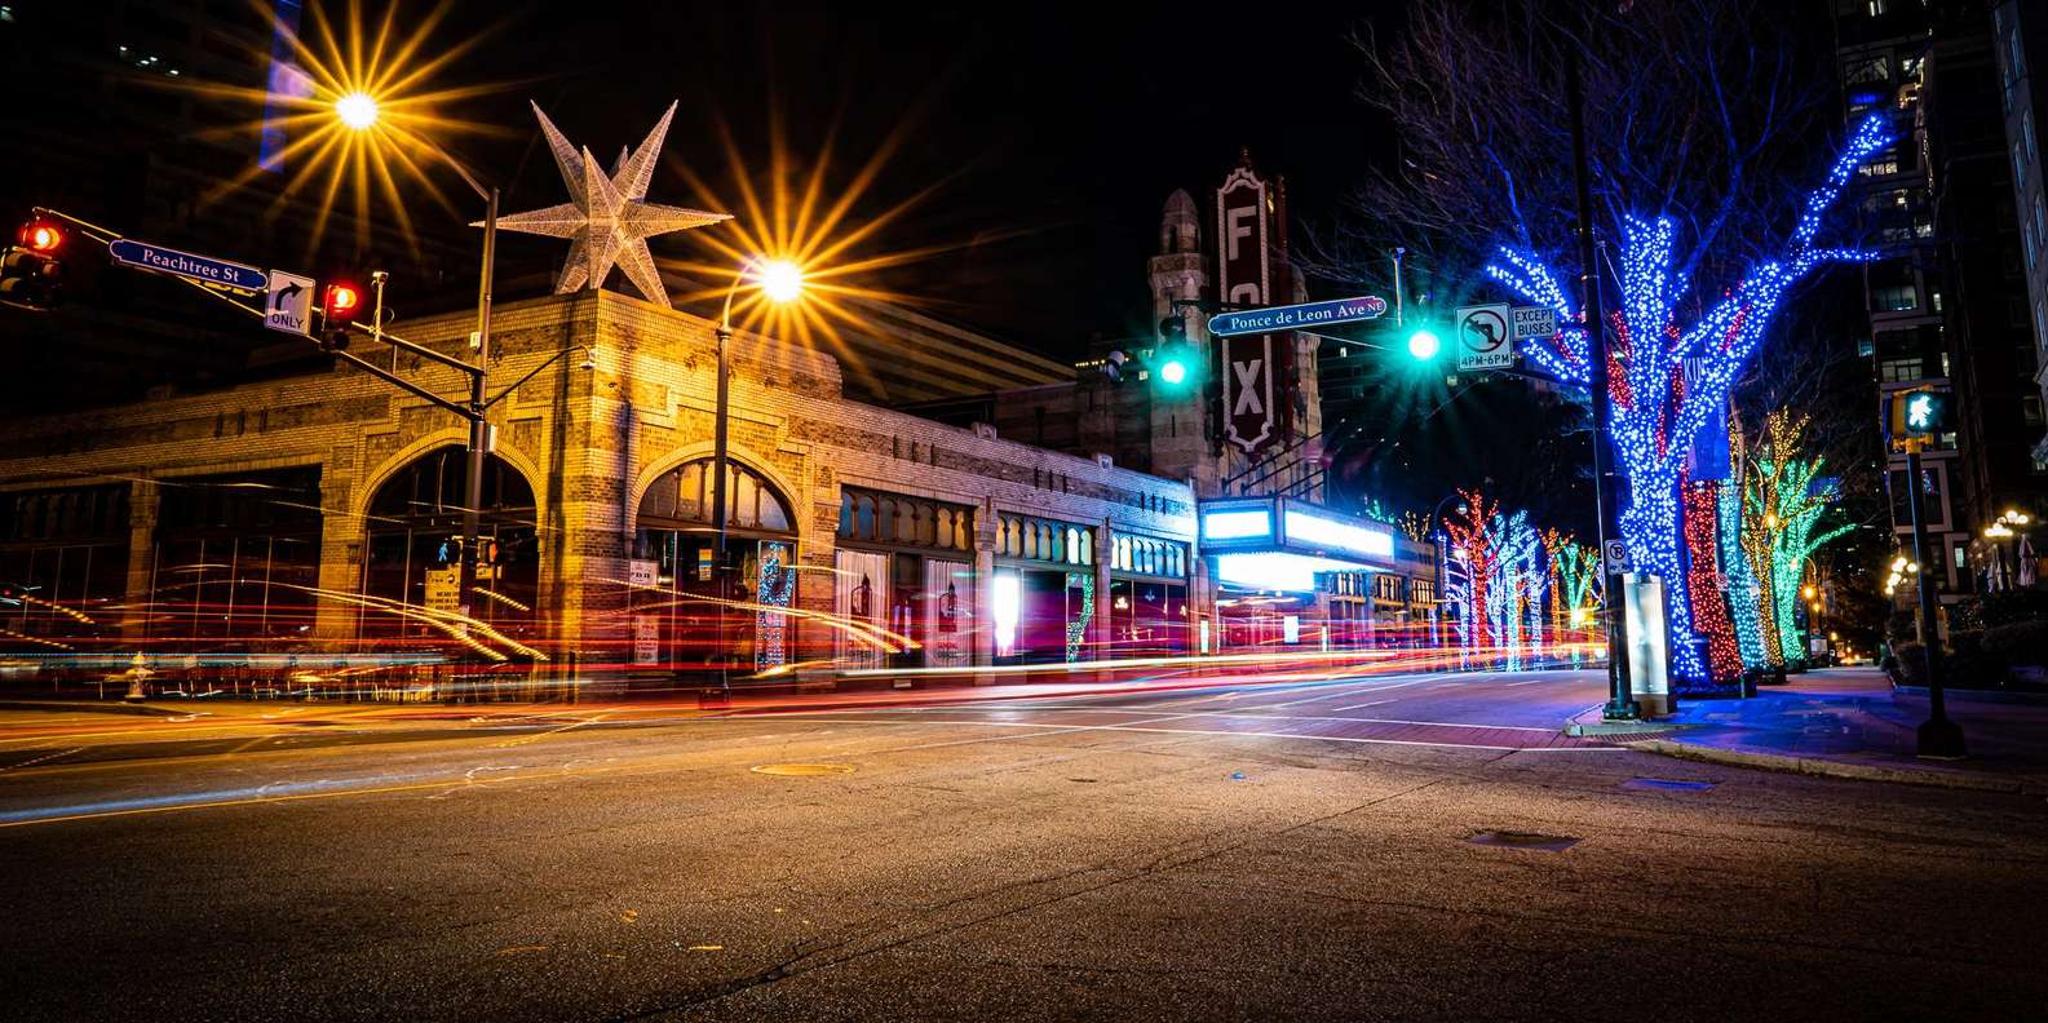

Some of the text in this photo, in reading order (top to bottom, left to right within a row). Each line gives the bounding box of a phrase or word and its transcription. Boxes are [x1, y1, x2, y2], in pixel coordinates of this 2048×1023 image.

[143, 249, 239, 282] Peachtree St
[271, 314, 304, 329] ONLY
[1231, 303, 1383, 330] Ponce de Leon Ave NE
[1515, 308, 1553, 322] EXCEPT
[1518, 323, 1553, 335] BUSES
[1462, 354, 1510, 366] 4PM-6PM
